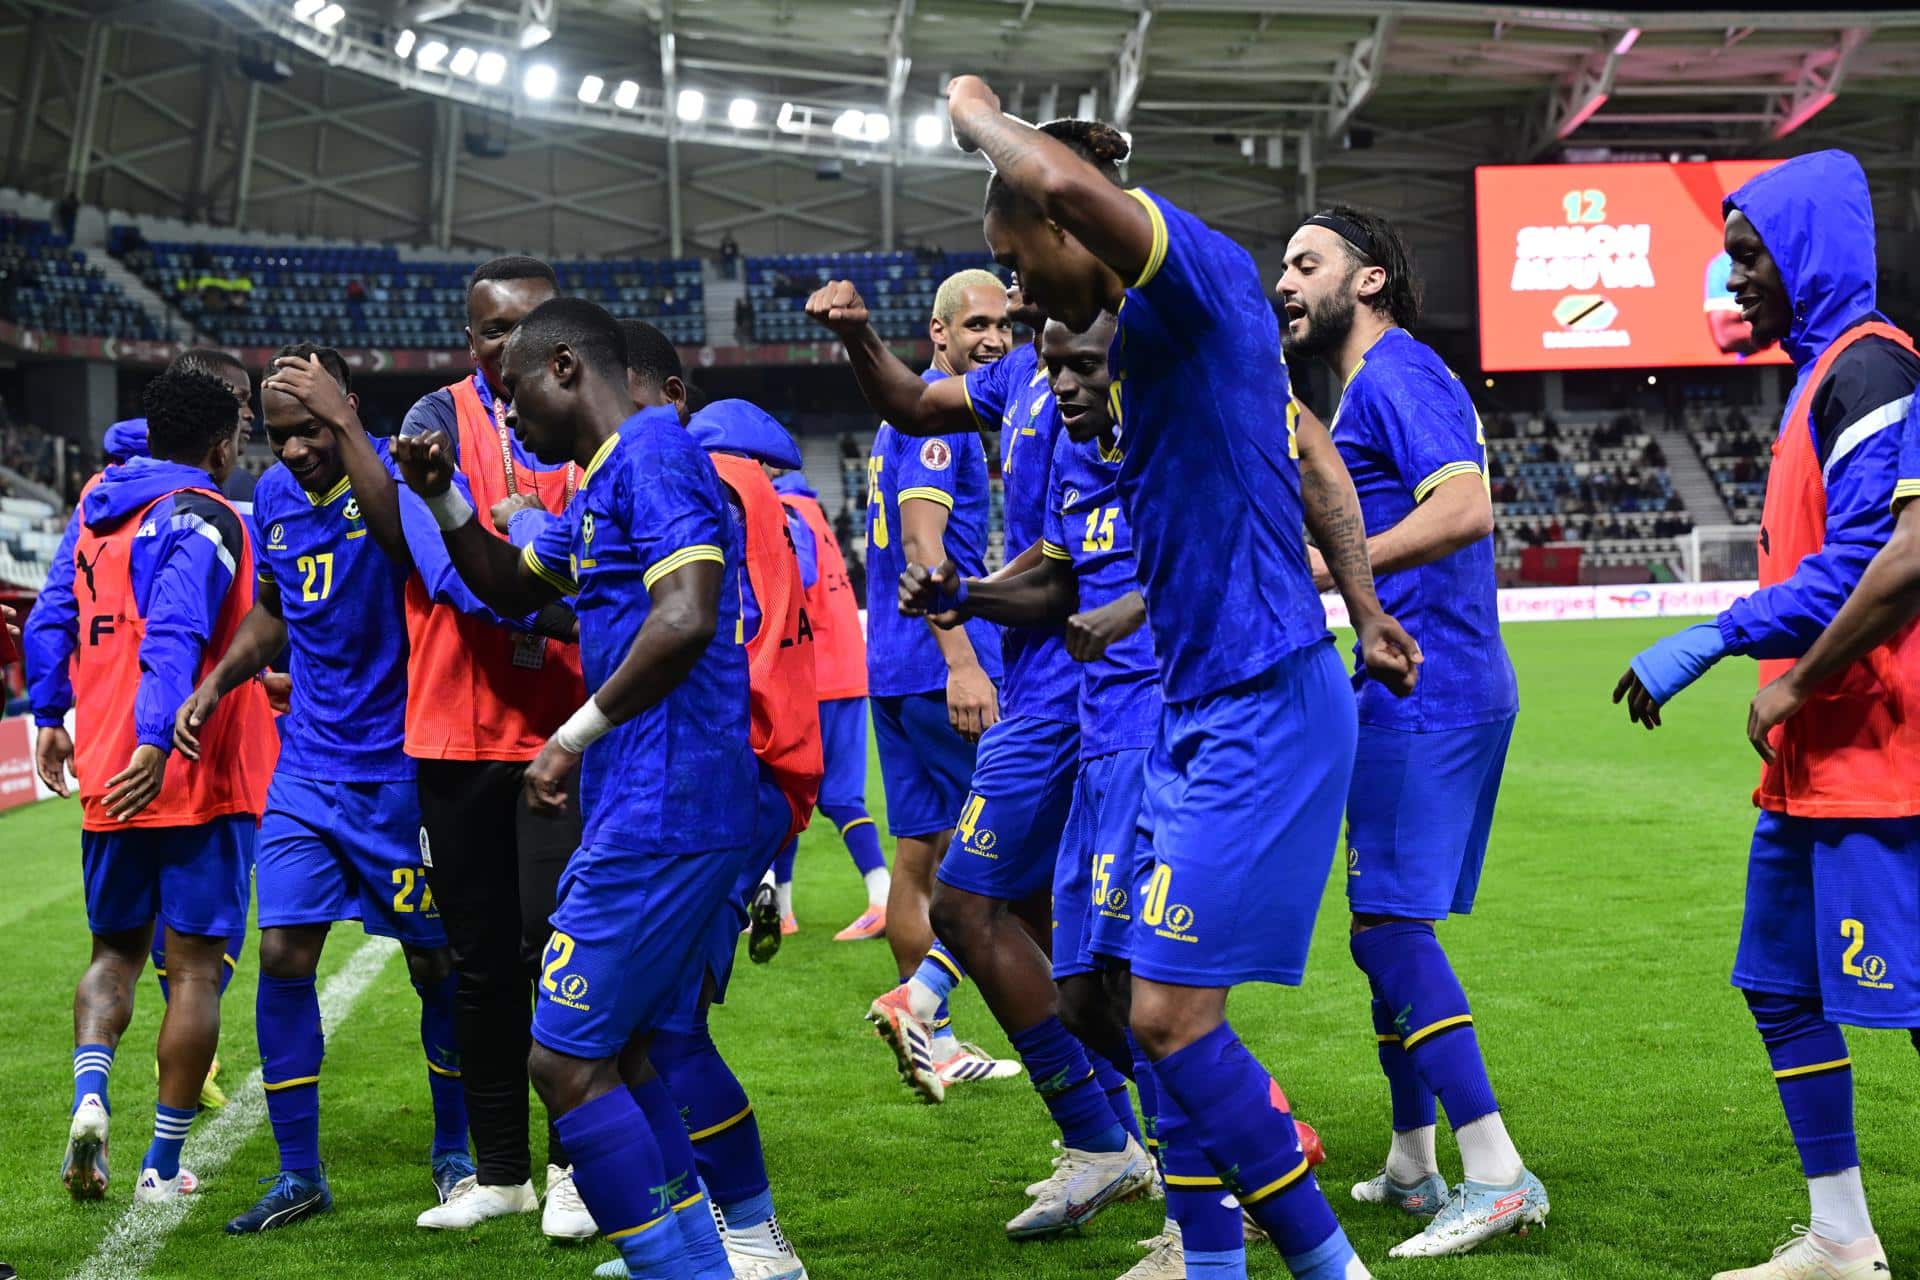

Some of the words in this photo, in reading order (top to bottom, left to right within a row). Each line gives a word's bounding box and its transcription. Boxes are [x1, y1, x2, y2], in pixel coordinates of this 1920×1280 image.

[1562, 188, 1607, 223] 12
[496, 413, 506, 429] CUP
[501, 440, 513, 474] NATIONS
[1082, 507, 1120, 552] 15
[297, 553, 334, 602] 27
[1503, 596, 1596, 617] Energies
[957, 793, 987, 844] 4
[541, 930, 576, 993] 2
[1840, 918, 1865, 978] 2
[549, 994, 591, 1012] SANDALAND
